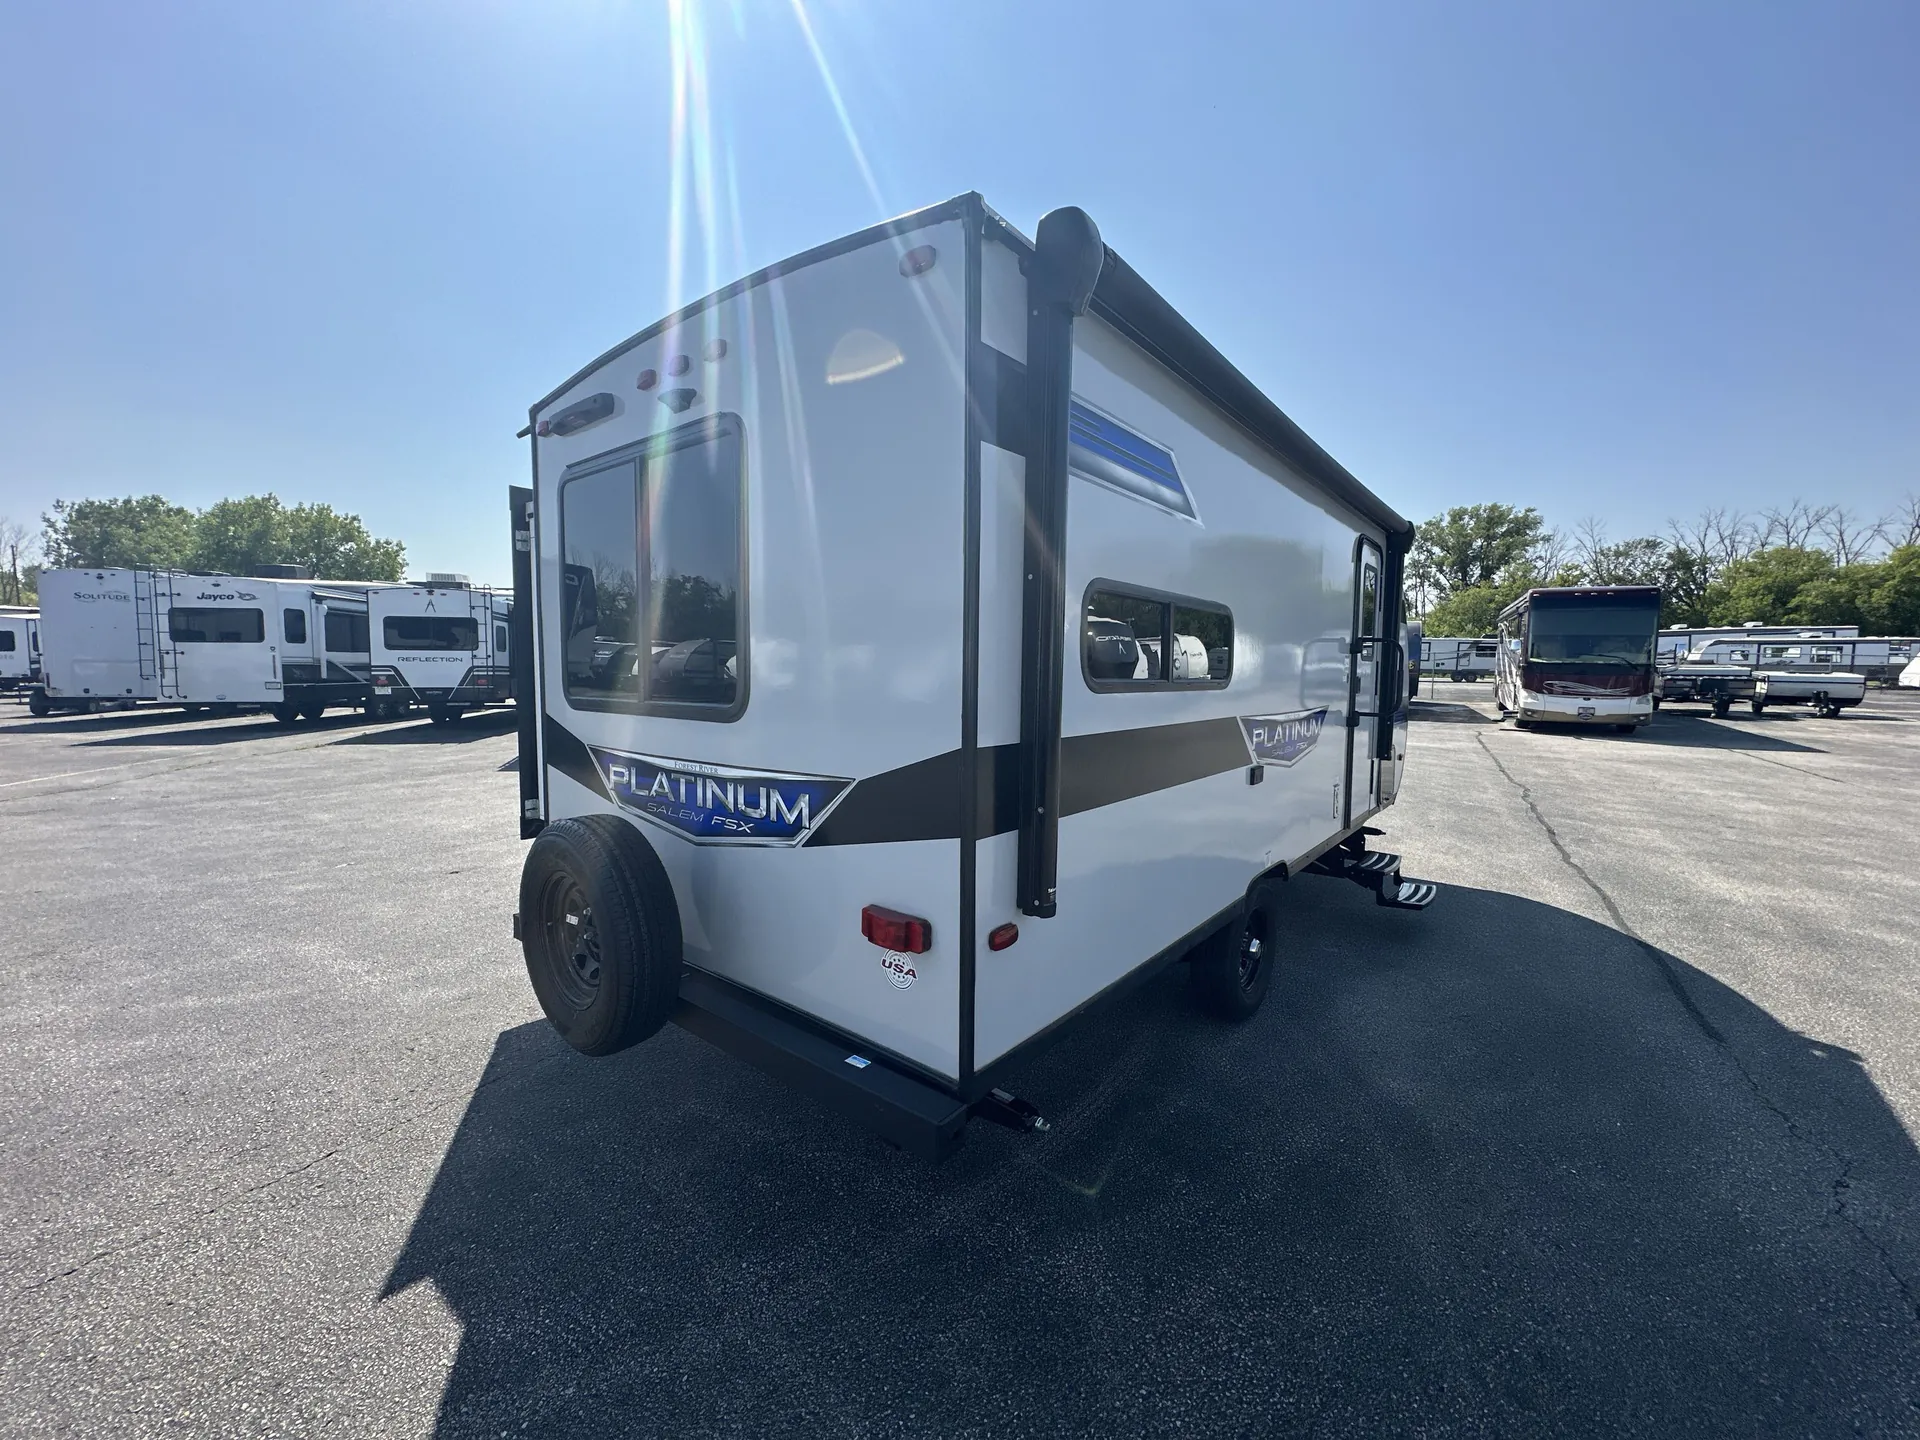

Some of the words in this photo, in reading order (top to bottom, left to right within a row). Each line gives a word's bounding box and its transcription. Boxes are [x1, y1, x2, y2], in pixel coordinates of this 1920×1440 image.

[73, 591, 131, 601] SOLITUDE
[196, 592, 235, 602] Jayco
[1251, 717, 1322, 751] PLATINUM
[674, 760, 698, 772] FOREST
[698, 763, 719, 774] RIVER
[608, 763, 811, 830] PLATINUM
[646, 802, 704, 822] SALEM
[711, 815, 755, 834] FSX
[881, 958, 917, 979] USA
